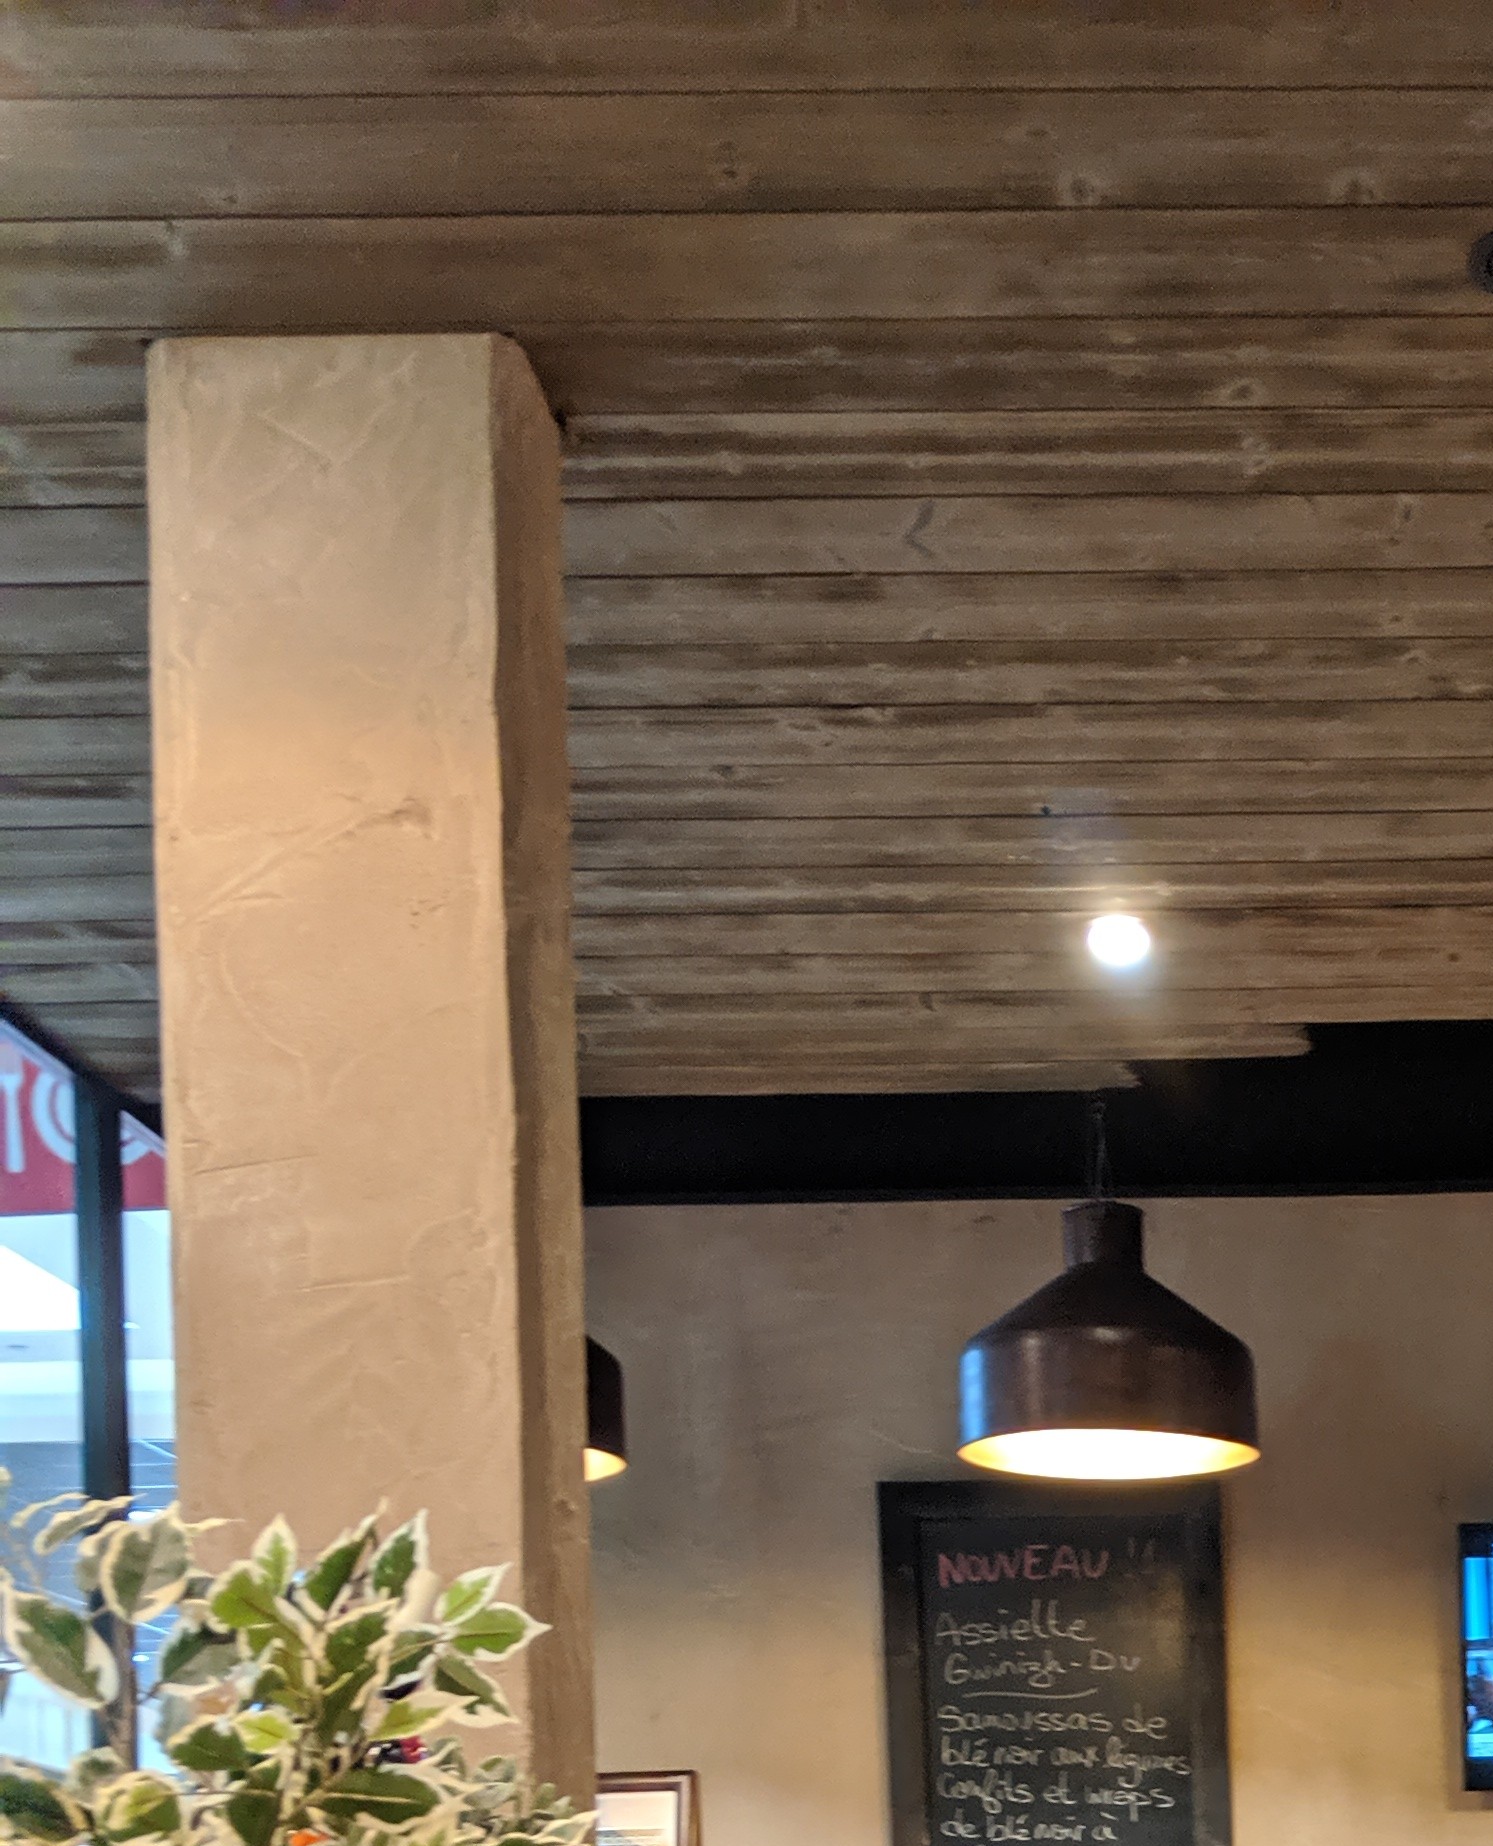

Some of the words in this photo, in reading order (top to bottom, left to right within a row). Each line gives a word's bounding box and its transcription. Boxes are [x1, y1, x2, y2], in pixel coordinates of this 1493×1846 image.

[938, 1545, 1110, 1588] NOUVEAU
[935, 1599, 1096, 1645] Assiette
[1121, 1703, 1168, 1739] de
[1043, 1771, 1077, 1805] et
[940, 1808, 981, 1838] de
[1091, 1811, 1119, 1841] à
